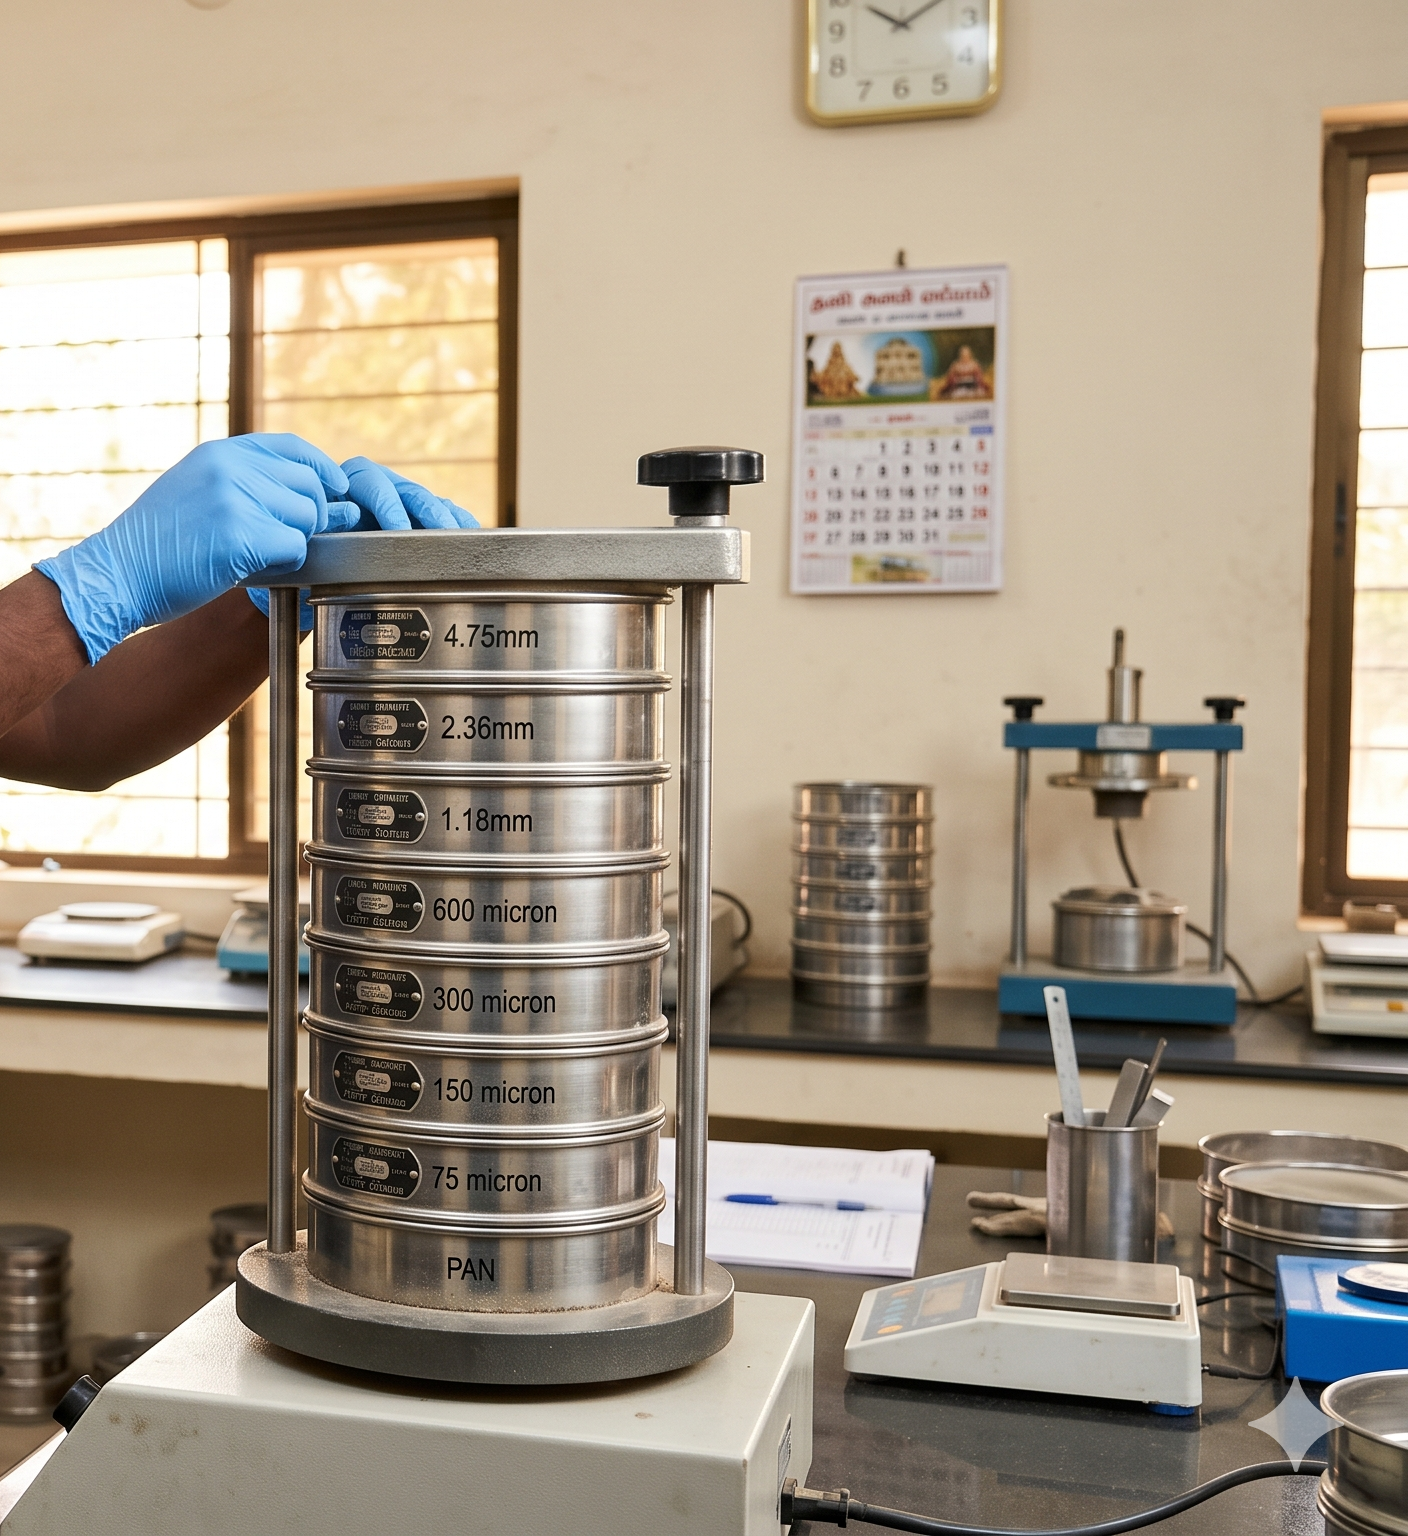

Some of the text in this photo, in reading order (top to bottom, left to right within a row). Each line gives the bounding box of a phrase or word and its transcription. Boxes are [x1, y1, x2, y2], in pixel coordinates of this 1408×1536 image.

[828, 19, 846, 43] 9
[961, 7, 978, 29] 3
[828, 54, 847, 79] 8
[957, 46, 974, 66] 4
[856, 73, 950, 102] 7 6 5
[443, 623, 539, 649] 4.75mm
[440, 714, 534, 740] 2.36mm
[441, 806, 533, 833] 1.18mm
[433, 897, 475, 922] 600
[482, 898, 557, 924] micron
[432, 986, 474, 1013] 300
[481, 988, 556, 1014] micron
[433, 1077, 474, 1103] 150
[481, 1079, 555, 1105] micron
[431, 1165, 459, 1191] 75
[466, 1167, 542, 1193] micron
[446, 1257, 496, 1282] PAN
